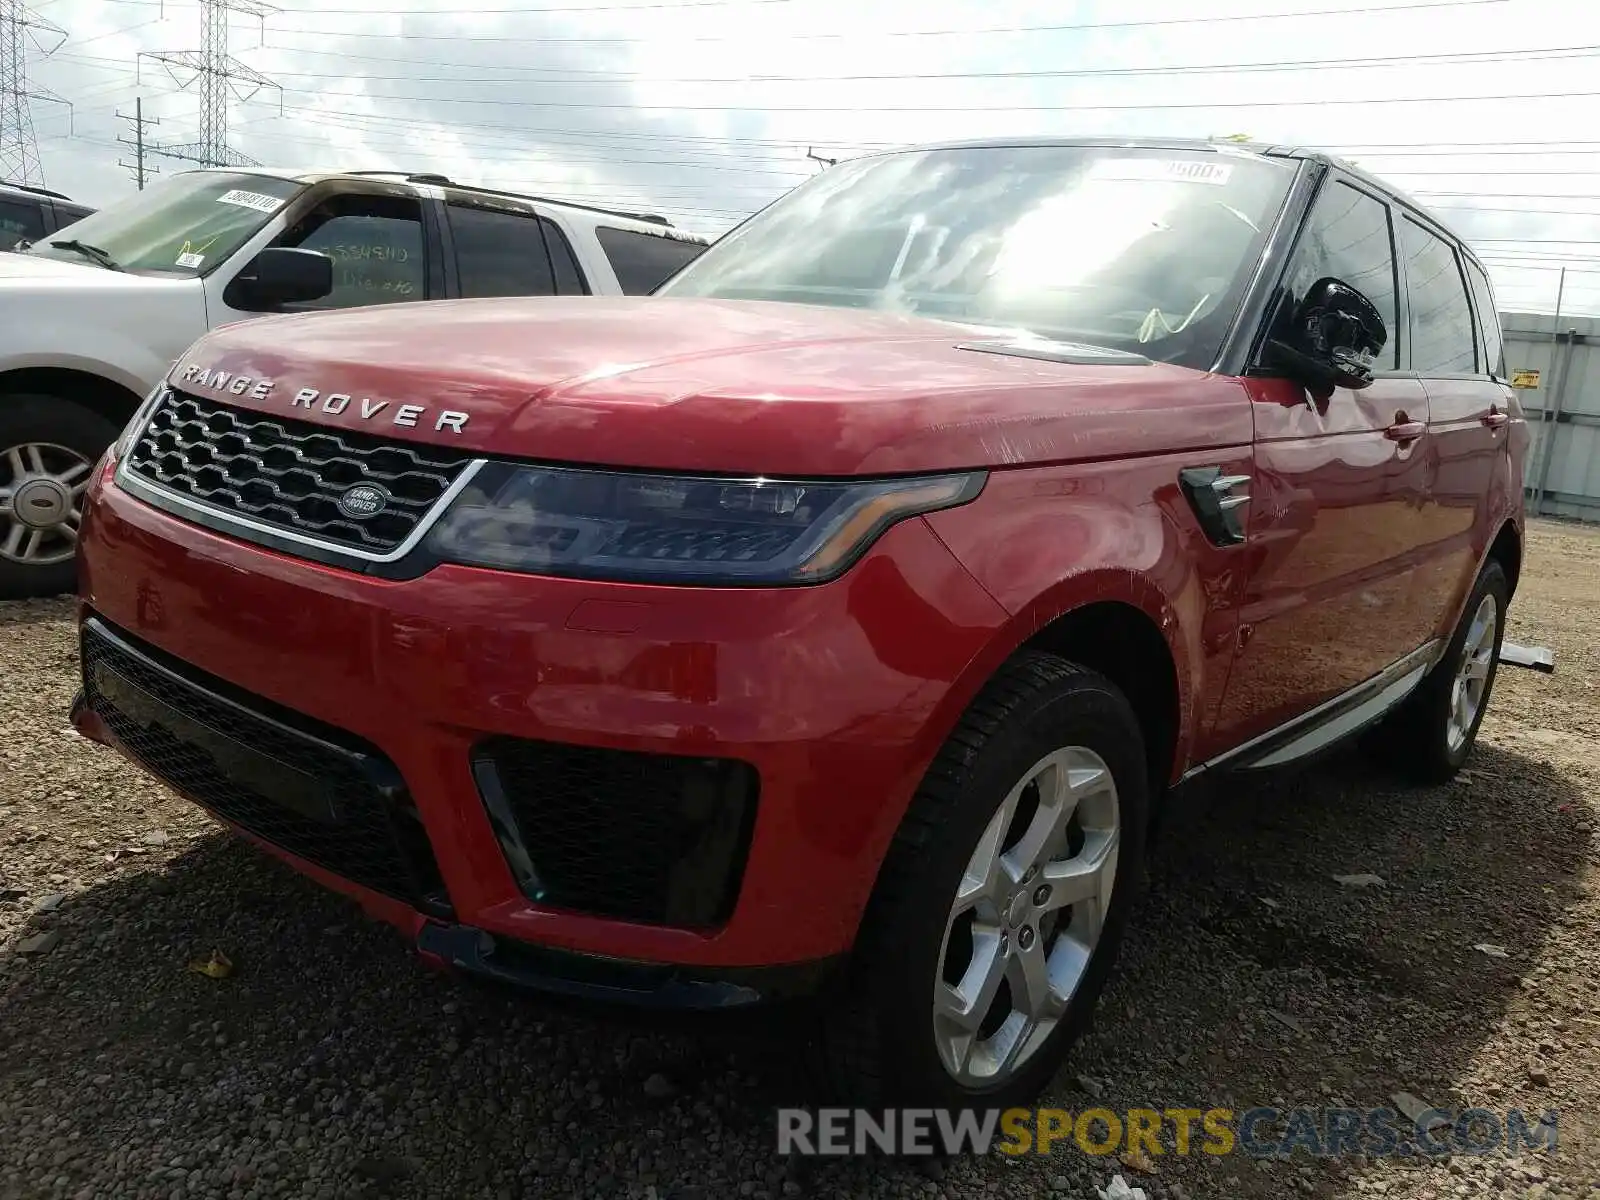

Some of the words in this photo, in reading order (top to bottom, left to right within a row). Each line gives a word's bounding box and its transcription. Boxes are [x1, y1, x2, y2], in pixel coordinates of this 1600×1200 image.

[183, 364, 275, 400] RANGE
[291, 387, 470, 434] ROVER
[351, 489, 375, 501] LAND
[347, 498, 377, 511] ROVER
